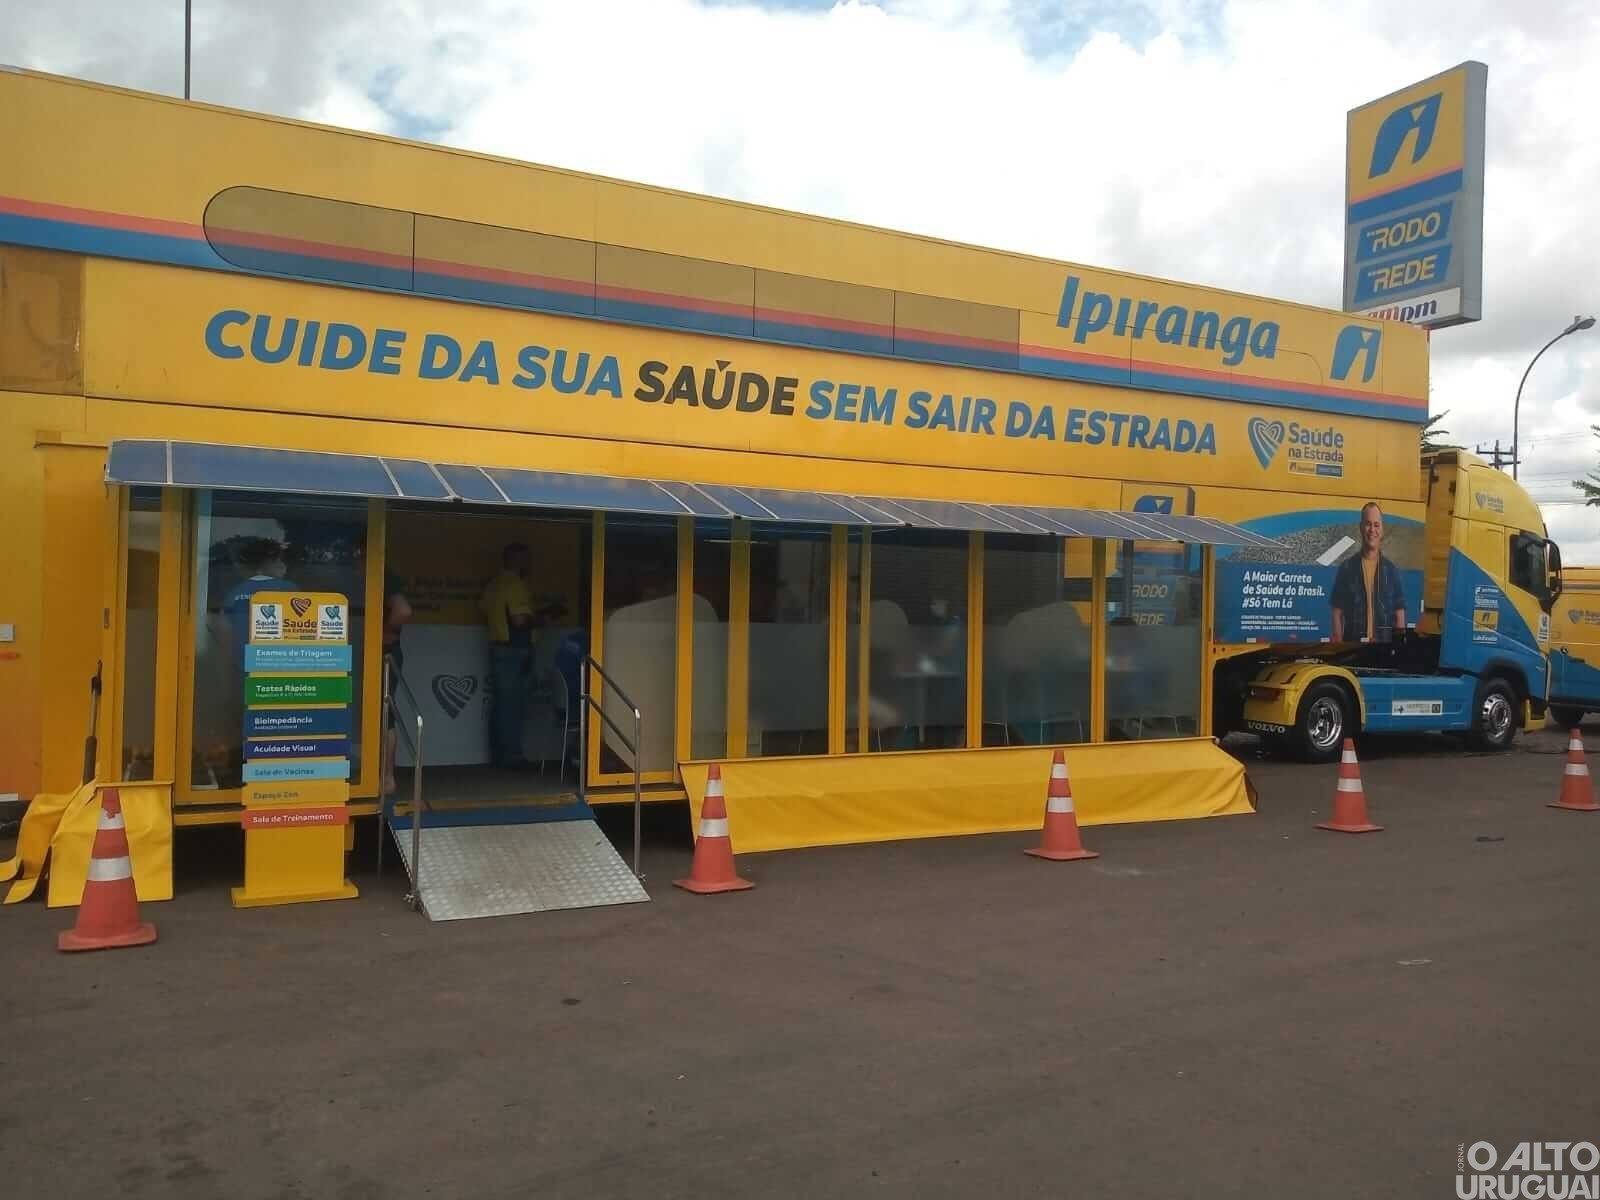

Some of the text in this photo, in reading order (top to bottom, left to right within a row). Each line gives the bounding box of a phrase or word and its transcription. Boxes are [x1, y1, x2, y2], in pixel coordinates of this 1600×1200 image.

[1367, 212, 1441, 253] RODO
[1368, 254, 1438, 293] REDE
[1056, 275, 1280, 366] Ipiranga
[205, 310, 1217, 455] CUIDE DA SUA SAÚDE SEM SAIR DA ESTRADA
[1288, 422, 1344, 448] Saúde
[1288, 447, 1344, 462] na Estrada
[1243, 571, 1312, 583] A Maior Carreta
[1242, 584, 1325, 596] de Saúde do Brasil.
[1263, 598, 1280, 608] Tem
[301, 650, 332, 658] Triagem
[285, 684, 316, 692] Rápidos
[254, 716, 313, 725] Bioimpedância
[254, 745, 290, 753] Acuidade
[252, 813, 334, 824] Sala de Treinamento
